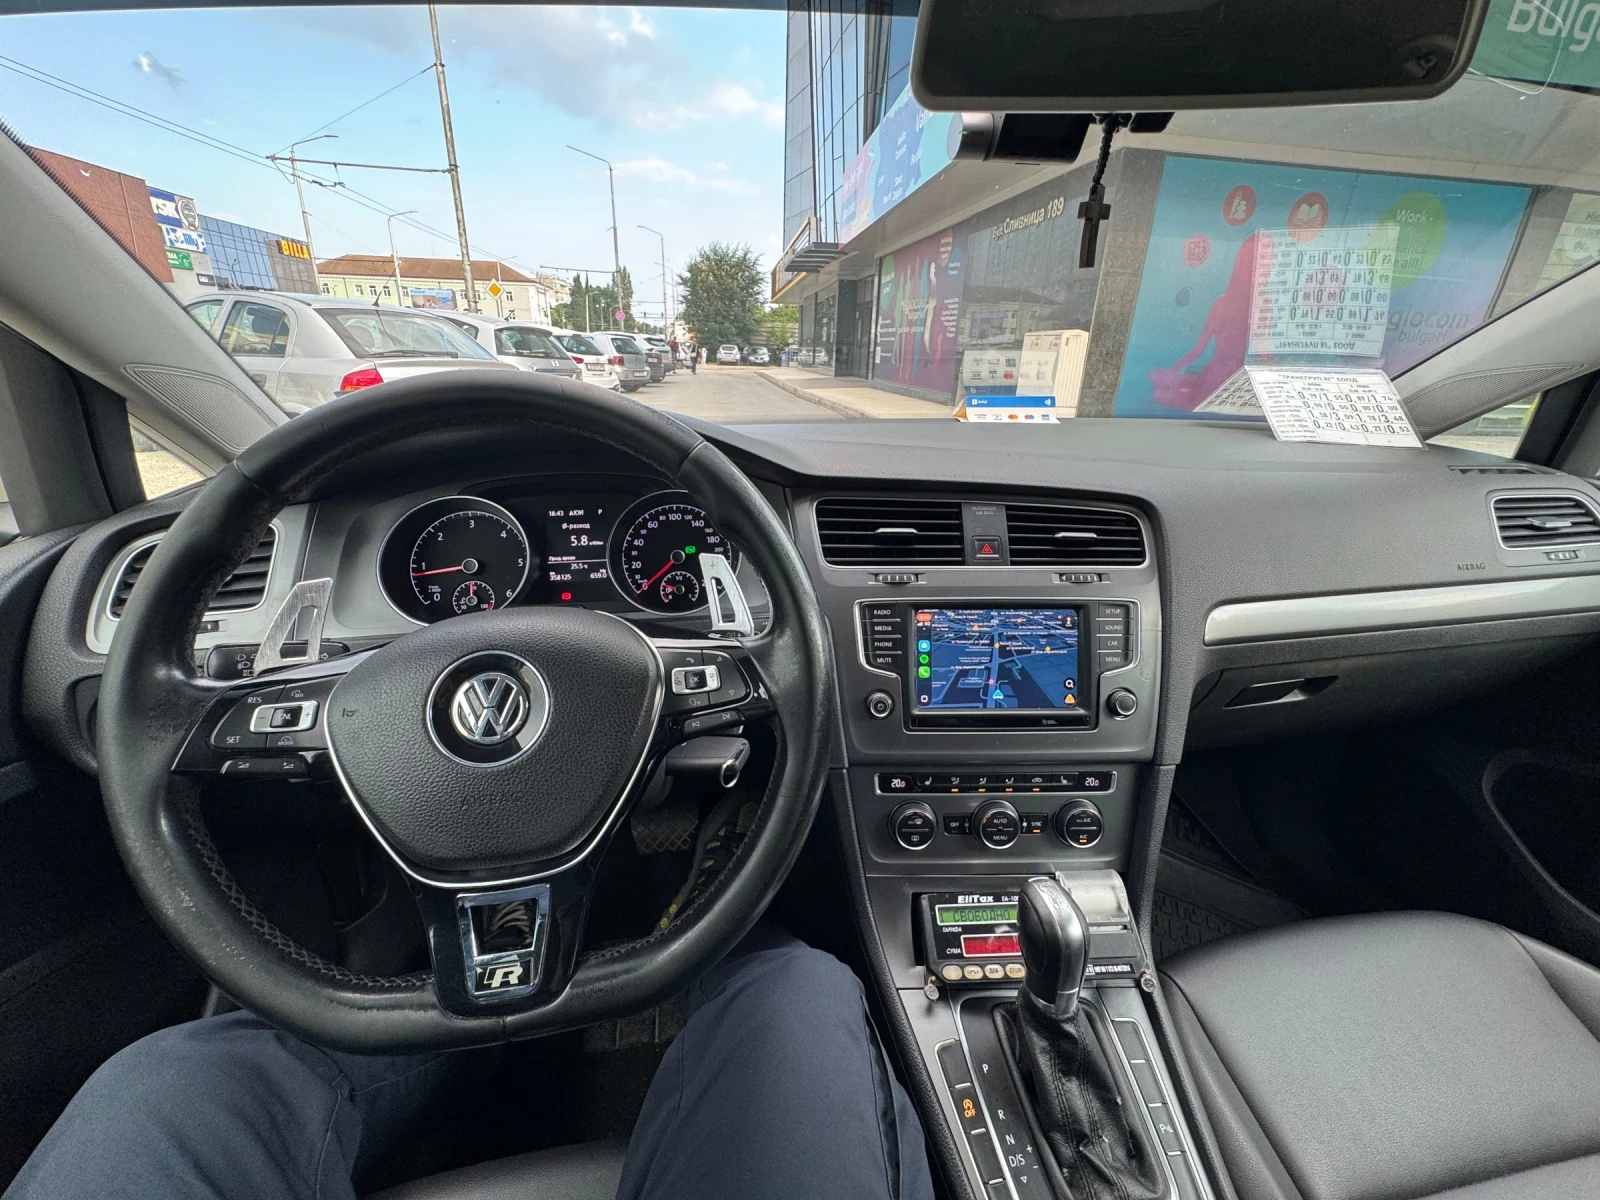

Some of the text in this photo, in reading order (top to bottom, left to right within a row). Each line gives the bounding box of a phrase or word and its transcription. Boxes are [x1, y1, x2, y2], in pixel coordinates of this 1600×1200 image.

[1506, 0, 1600, 52] Bulg
[1003, 207, 1046, 234] Сливница
[1047, 196, 1065, 219] 189
[280, 239, 310, 260] BILLA
[668, 513, 682, 521] 100
[469, 519, 475, 528] 3
[647, 521, 659, 529] 60
[691, 520, 705, 528] 140
[437, 532, 443, 541] 2
[500, 530, 507, 539] 4
[570, 535, 588, 547] 5.8
[633, 538, 644, 546] 40
[707, 536, 720, 544] 180
[421, 562, 426, 571] 1
[517, 558, 523, 567] 5
[631, 561, 641, 569] 20
[1457, 562, 1486, 571] AIRBAG
[506, 589, 513, 598] 6
[247, 696, 262, 704] RES
[226, 736, 241, 744] SET
[891, 778, 905, 788] 20.0
[1085, 777, 1099, 786] 20.0
[953, 909, 1011, 922] СВОБОДНО
[487, 965, 523, 988] R
[982, 1063, 988, 1074] P
[964, 1108, 976, 1118] OFF
[998, 1109, 1006, 1120] R
[1005, 1134, 1015, 1145] N
[1008, 1153, 1026, 1167] D/S
